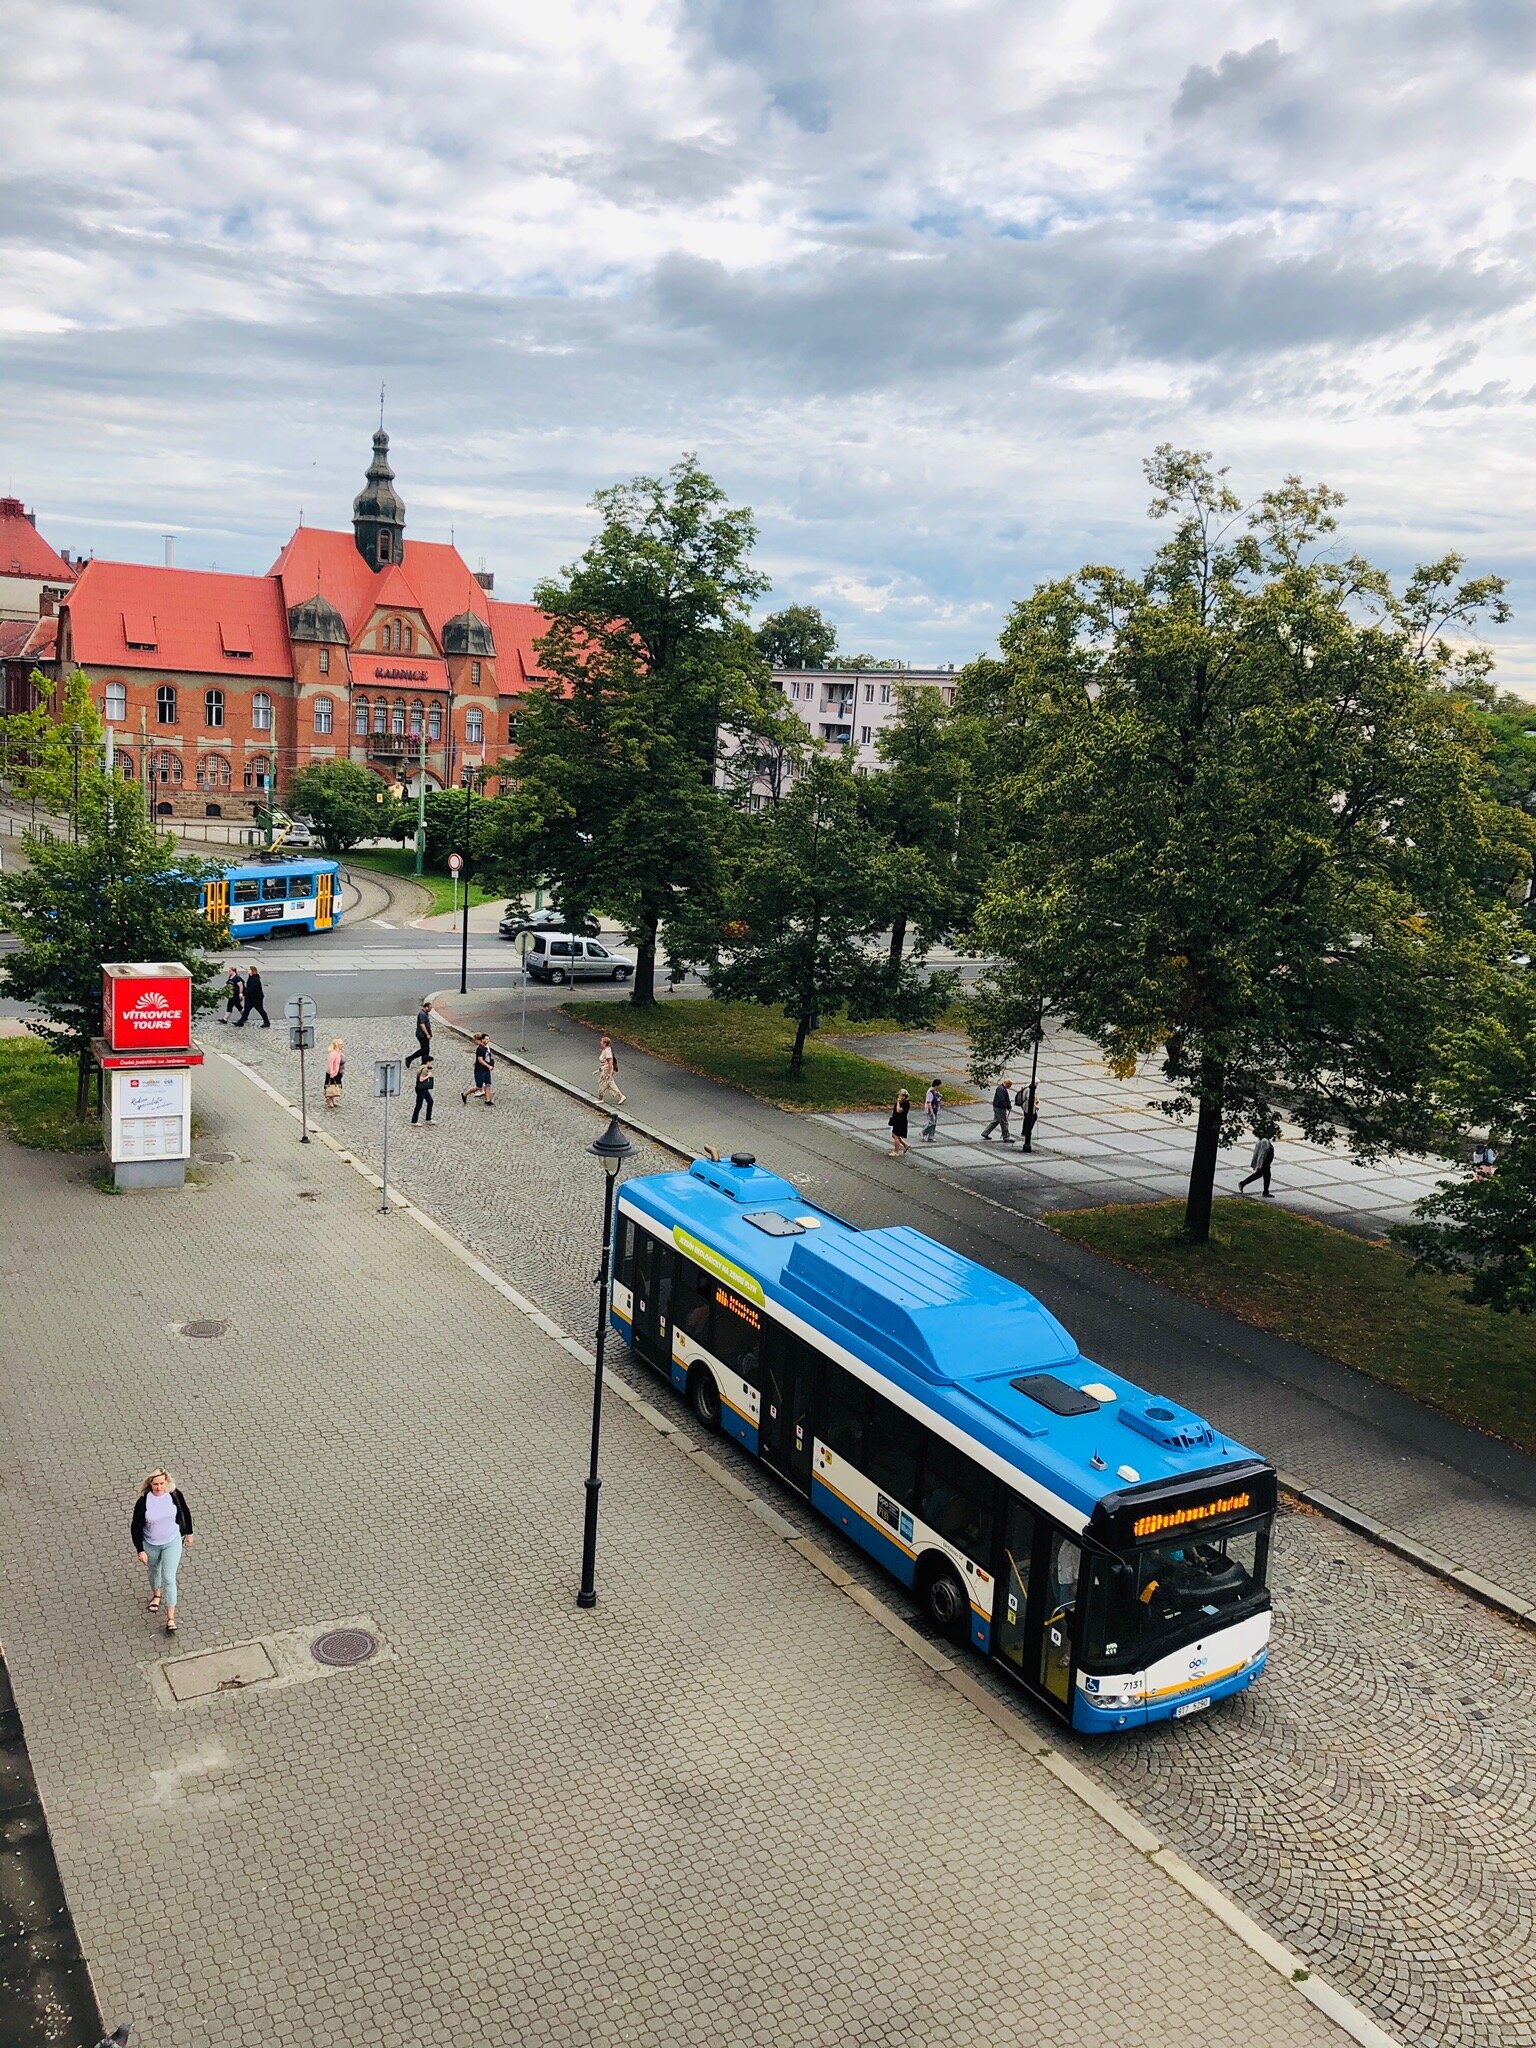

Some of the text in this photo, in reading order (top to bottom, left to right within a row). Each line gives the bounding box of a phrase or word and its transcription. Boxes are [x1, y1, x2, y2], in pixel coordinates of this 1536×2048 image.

[375, 667, 429, 681] RADNICE
[122, 1009, 182, 1019] VÍTKOVICE
[133, 1020, 171, 1029] TOURS
[878, 1506, 889, 1521] 7131
[1123, 1680, 1143, 1691] 7131
